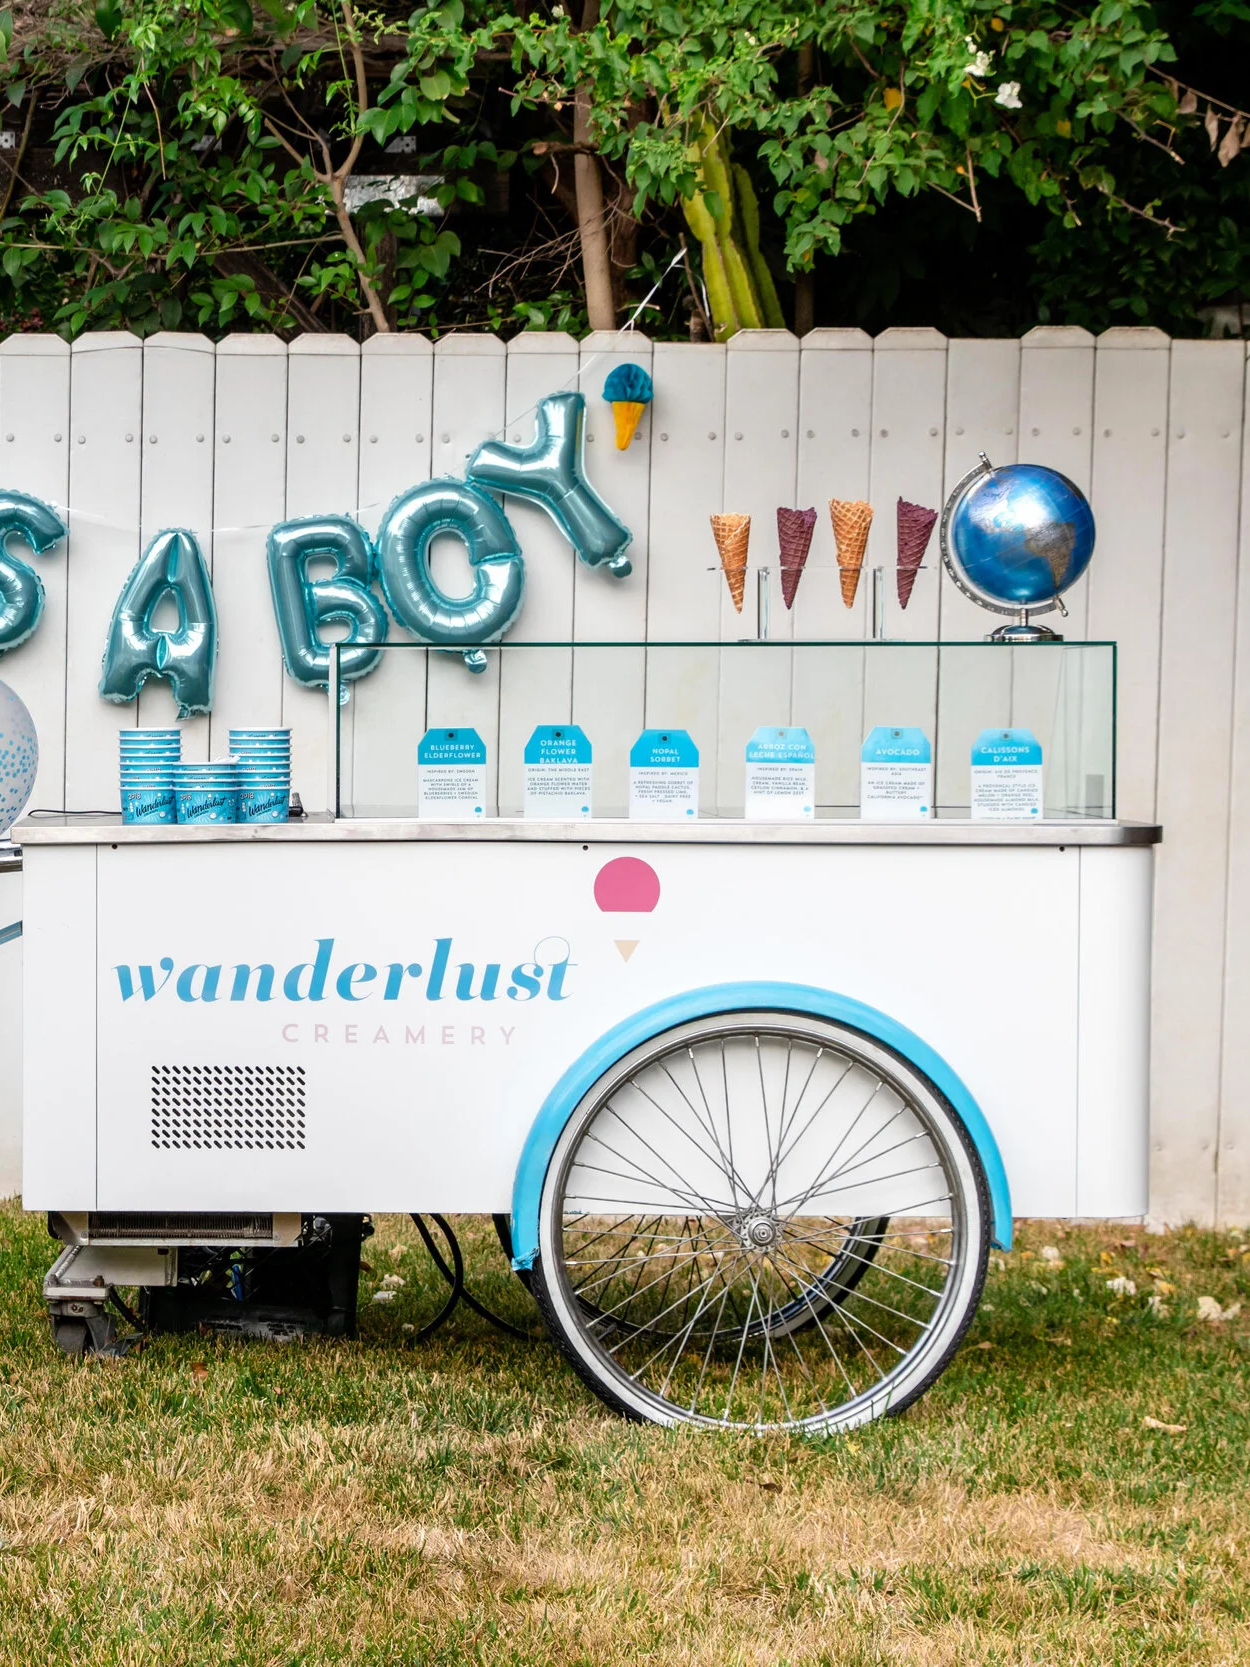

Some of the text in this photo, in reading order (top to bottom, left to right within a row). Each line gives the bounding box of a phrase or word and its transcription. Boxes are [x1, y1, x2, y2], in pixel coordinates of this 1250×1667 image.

[98, 528, 219, 721] A
[267, 390, 633, 704] BOY
[136, 796, 174, 817] Wanderlust
[186, 796, 226, 818] Wanderlust
[248, 796, 286, 816] Wanderlust
[110, 936, 578, 1002] wanderlust
[282, 1023, 519, 1045] CREAMERY
